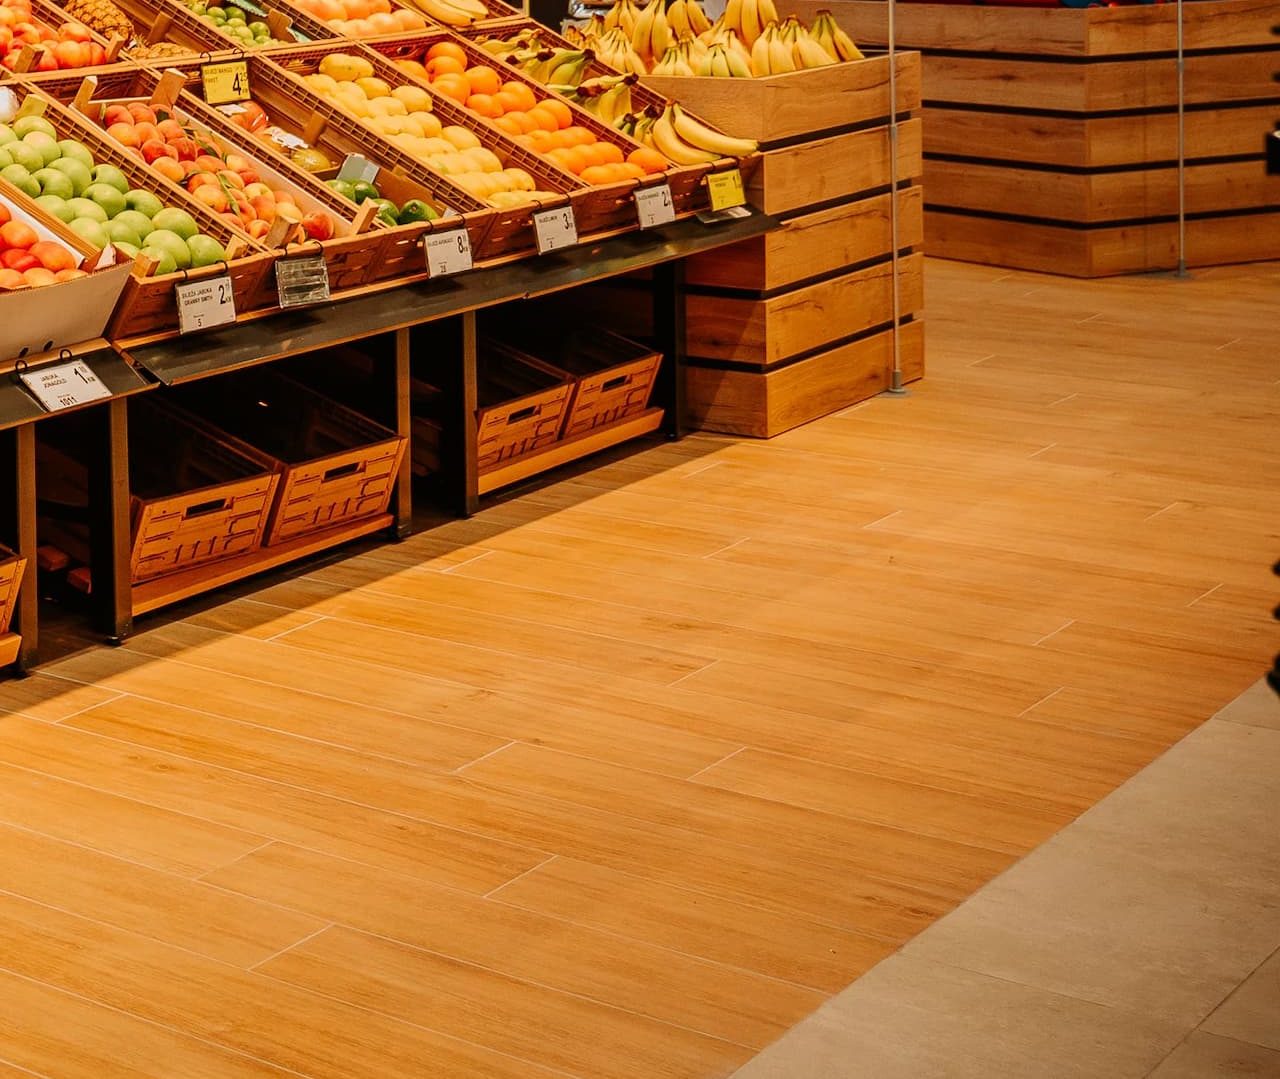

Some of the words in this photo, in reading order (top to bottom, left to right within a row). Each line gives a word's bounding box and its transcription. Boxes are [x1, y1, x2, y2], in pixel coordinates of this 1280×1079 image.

[233, 72, 241, 95] 4
[563, 213, 569, 230] 3
[457, 235, 464, 254] 8
[218, 284, 226, 304] 2
[74, 367, 89, 384] 1
